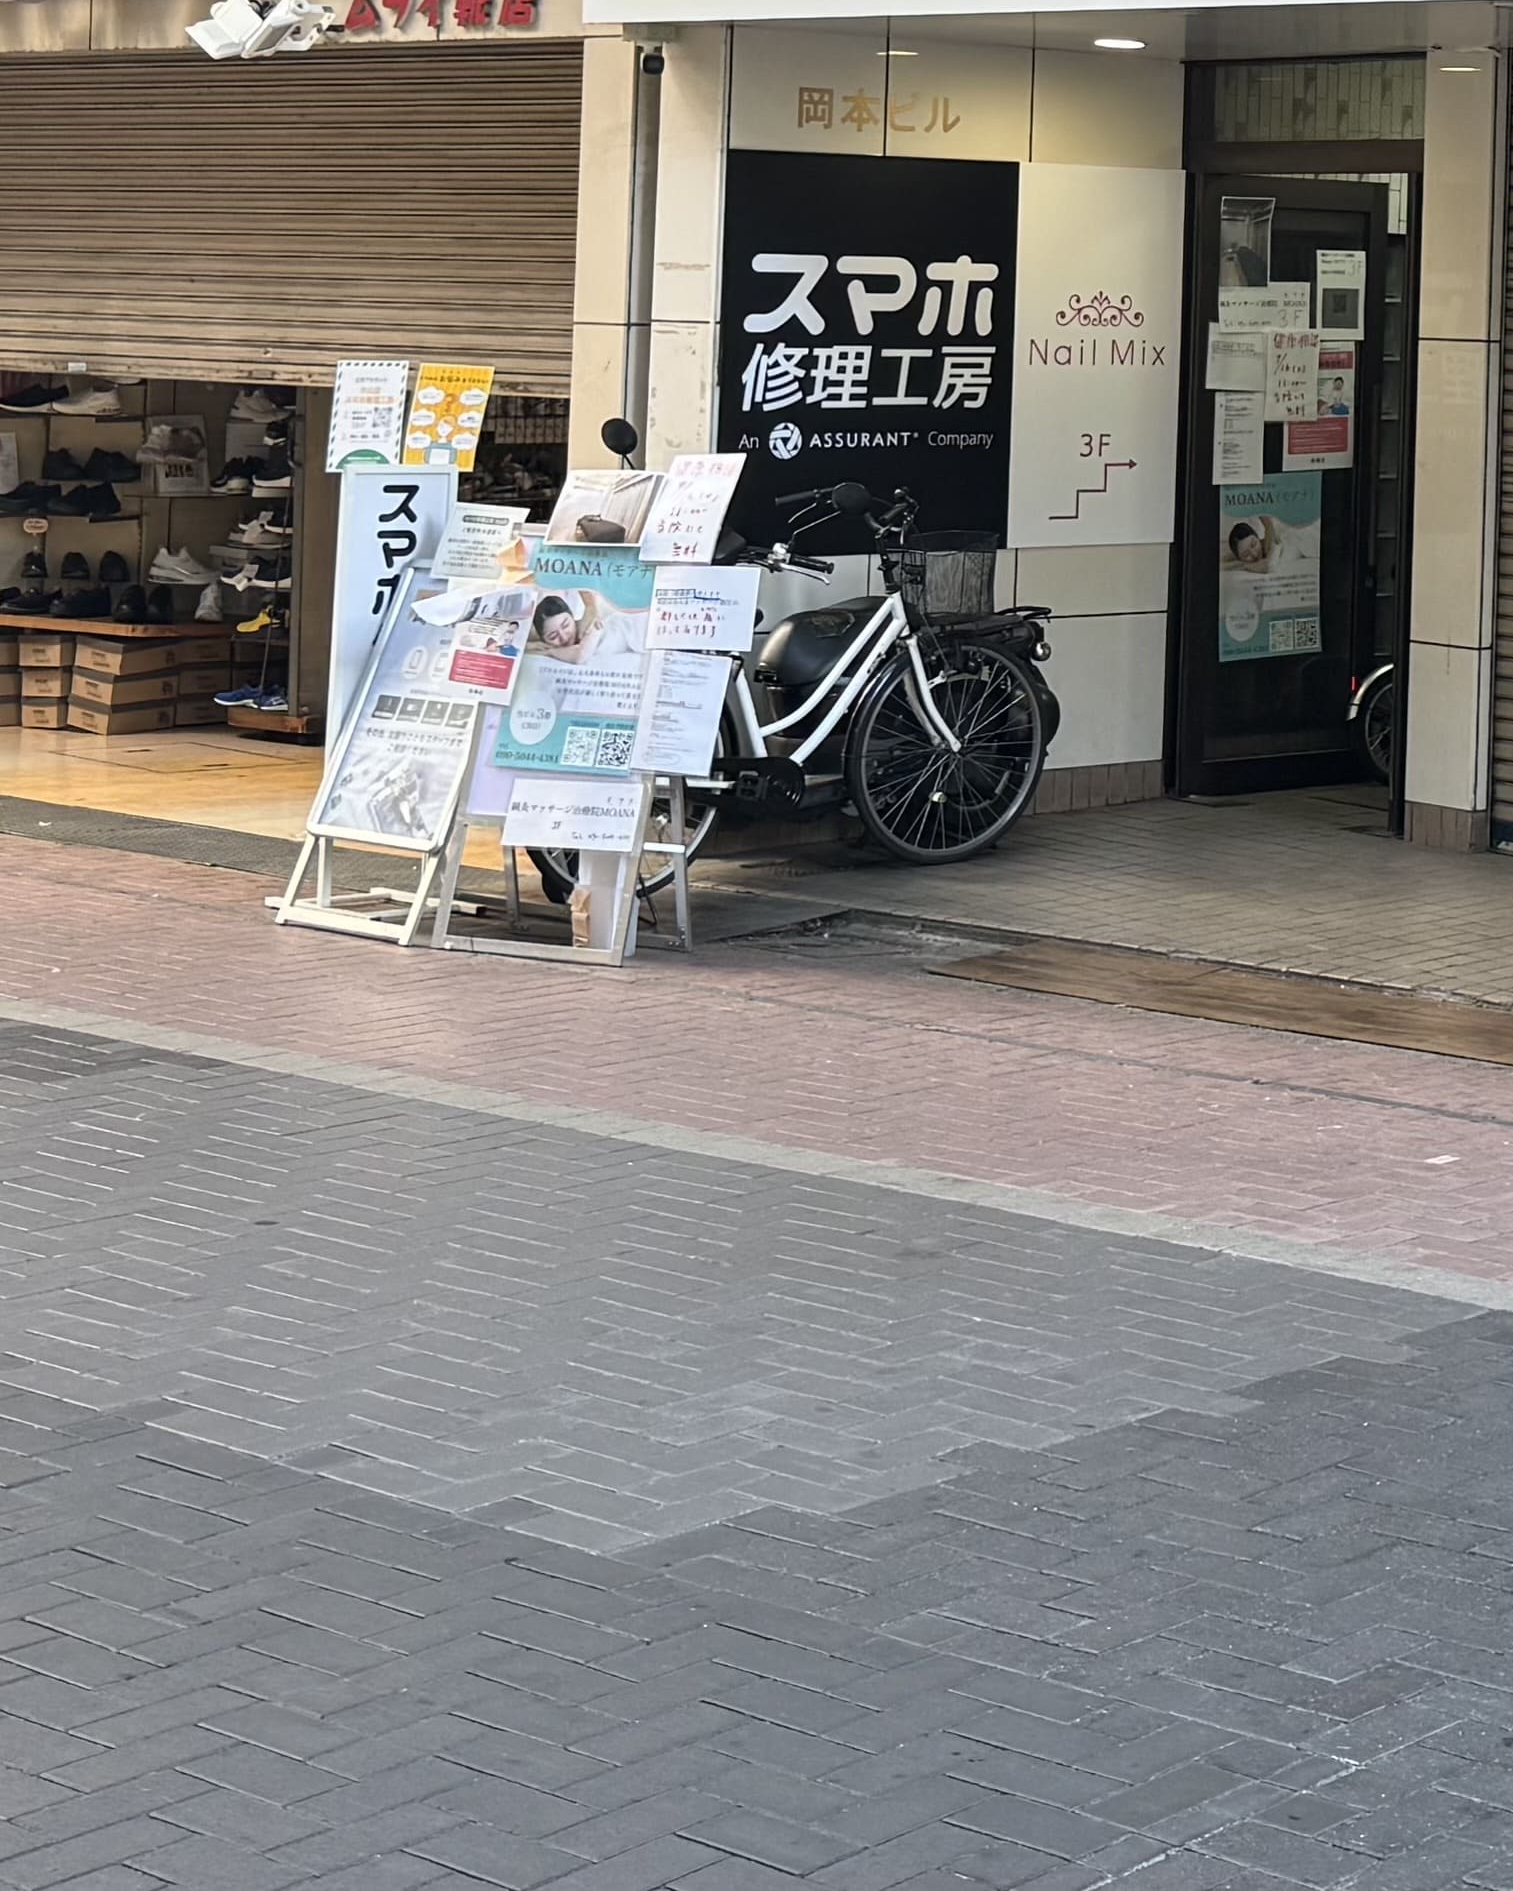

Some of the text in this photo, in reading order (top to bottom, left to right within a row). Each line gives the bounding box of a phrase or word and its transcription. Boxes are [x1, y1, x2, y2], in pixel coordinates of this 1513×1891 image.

[797, 86, 961, 133] 岡本ビル
[743, 253, 1000, 337] スマホ
[1029, 338, 1166, 366] Nail Mix
[741, 342, 993, 412] 修理工房
[738, 434, 760, 449] An
[927, 430, 994, 450] Company
[1079, 433, 1112, 458] 3F
[535, 557, 602, 577] MOANA
